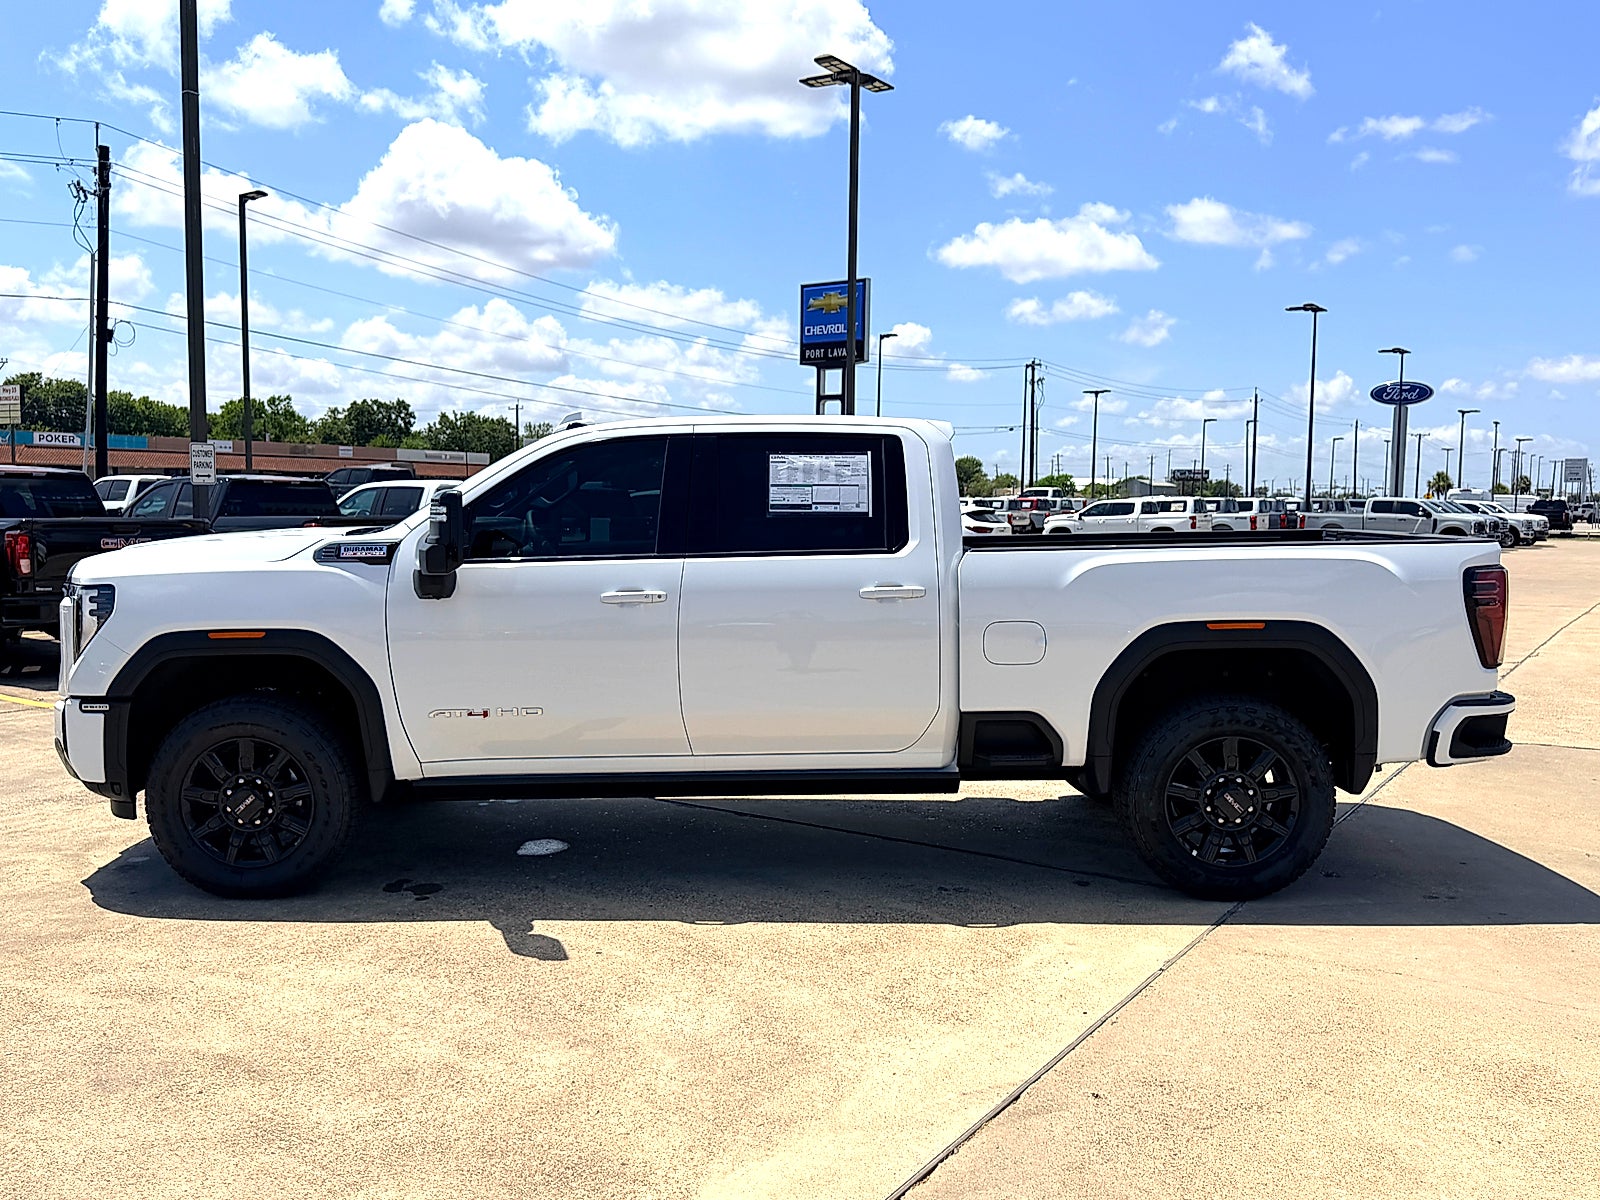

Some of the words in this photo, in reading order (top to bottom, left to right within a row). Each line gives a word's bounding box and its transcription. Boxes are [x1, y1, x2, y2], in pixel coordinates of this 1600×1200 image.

[804, 322, 859, 336] CHEVROLT
[805, 349, 825, 359] PORT
[828, 347, 858, 358] LAVA
[1382, 386, 1420, 400] Ford
[38, 434, 76, 444] POKER
[193, 449, 213, 458] CUSTOMER
[193, 460, 213, 469] PARKING
[496, 707, 543, 716] HD
